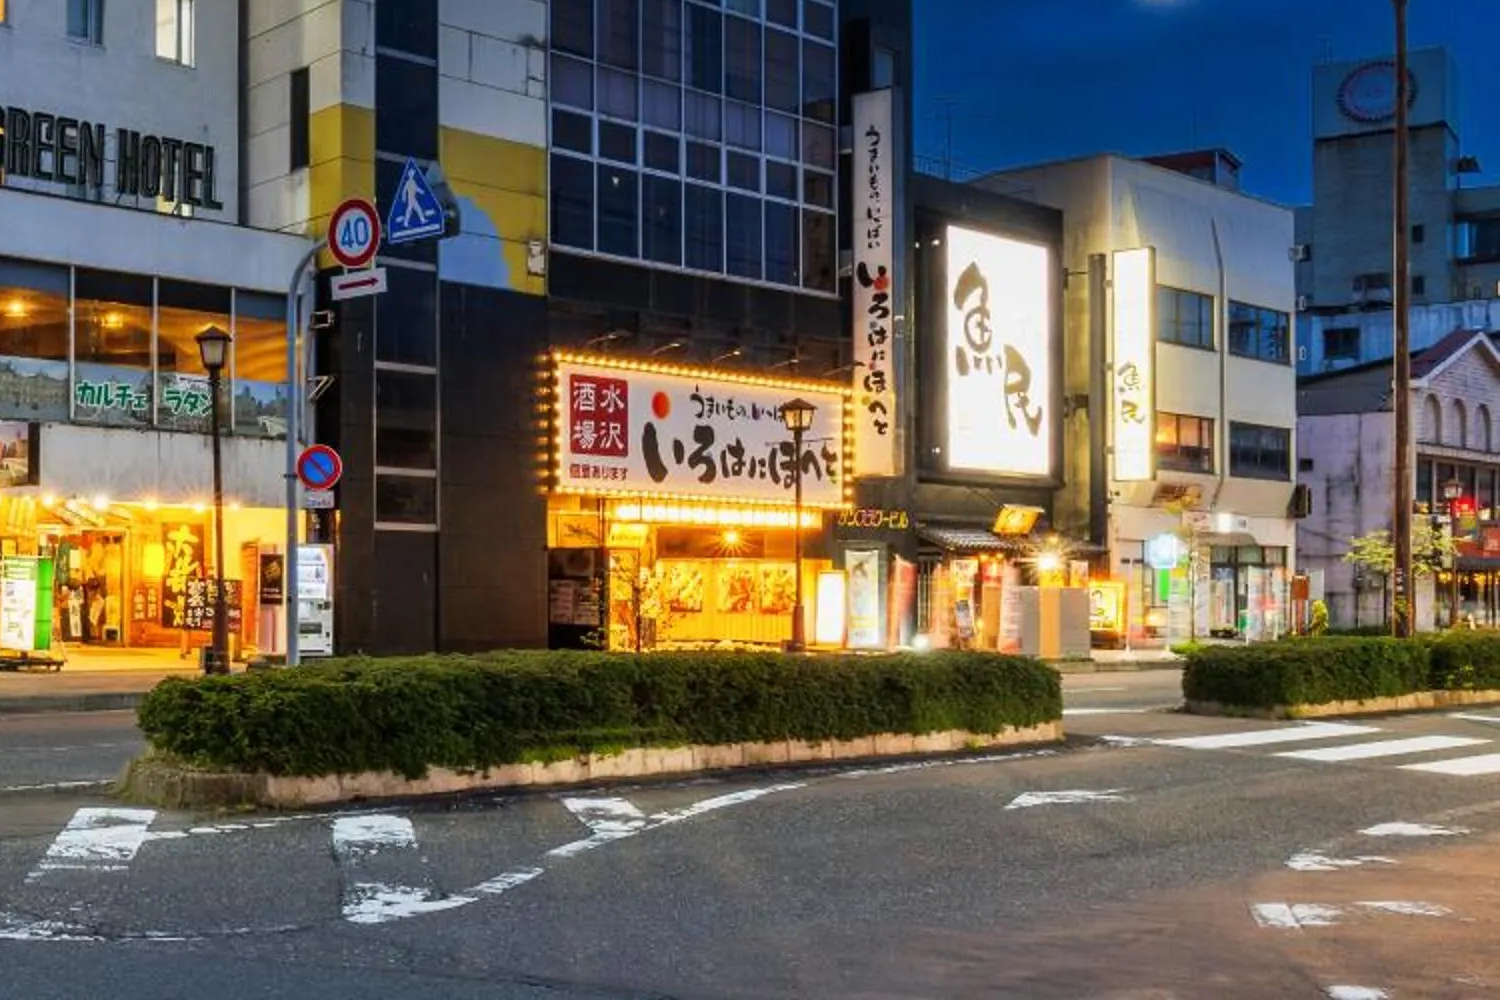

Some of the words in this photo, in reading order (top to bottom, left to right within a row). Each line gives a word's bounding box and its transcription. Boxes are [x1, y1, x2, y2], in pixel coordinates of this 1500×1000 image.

[116, 127, 223, 210] HOTEL
[341, 217, 369, 248] 40
[857, 262, 889, 436] いろはにほへと
[953, 262, 1043, 437] 魚民
[642, 422, 837, 490] いろはにほへと
